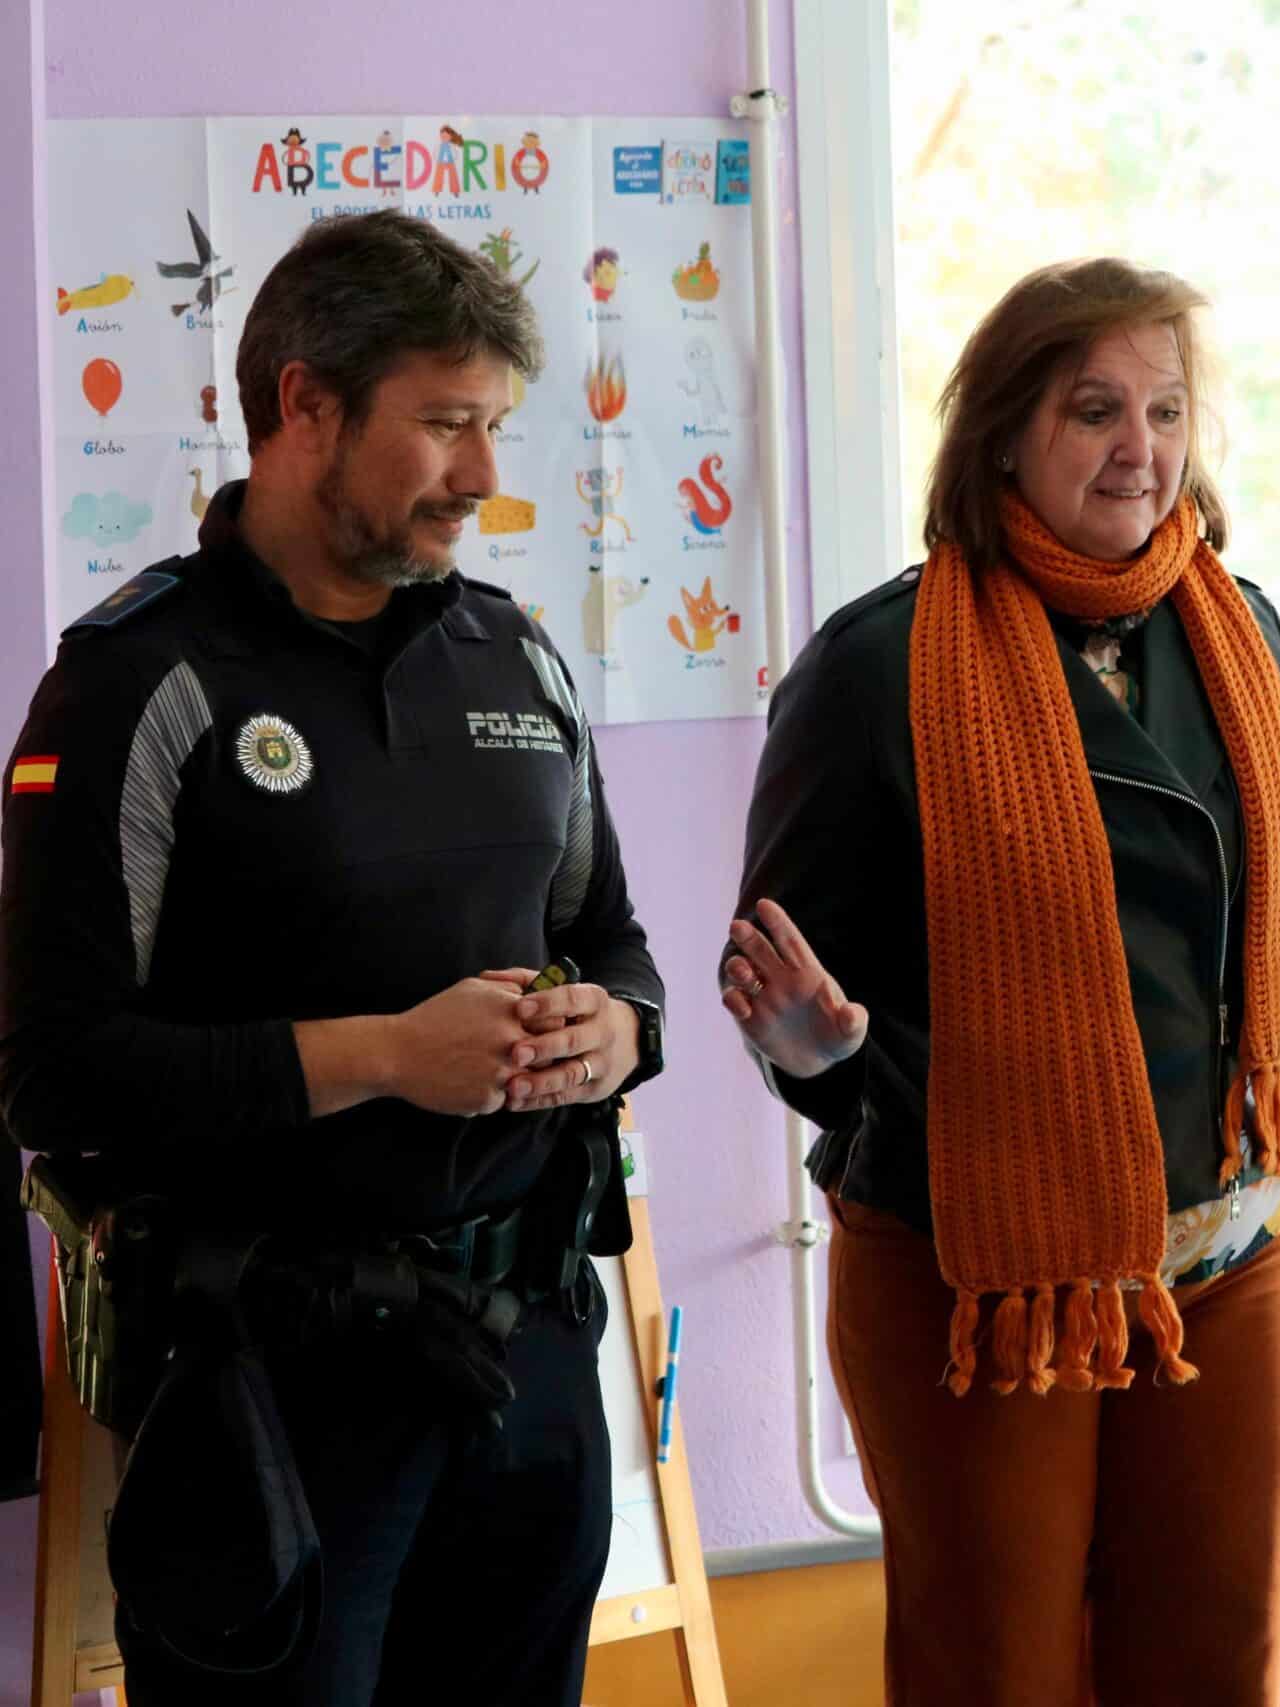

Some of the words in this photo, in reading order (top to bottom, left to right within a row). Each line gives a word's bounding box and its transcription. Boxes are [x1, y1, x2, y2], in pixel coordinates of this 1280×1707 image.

[252, 126, 549, 197] ABECEDARIO
[439, 205, 492, 218] LETRAS
[83, 441, 127, 455] Globo
[465, 711, 561, 740] POLICIA
